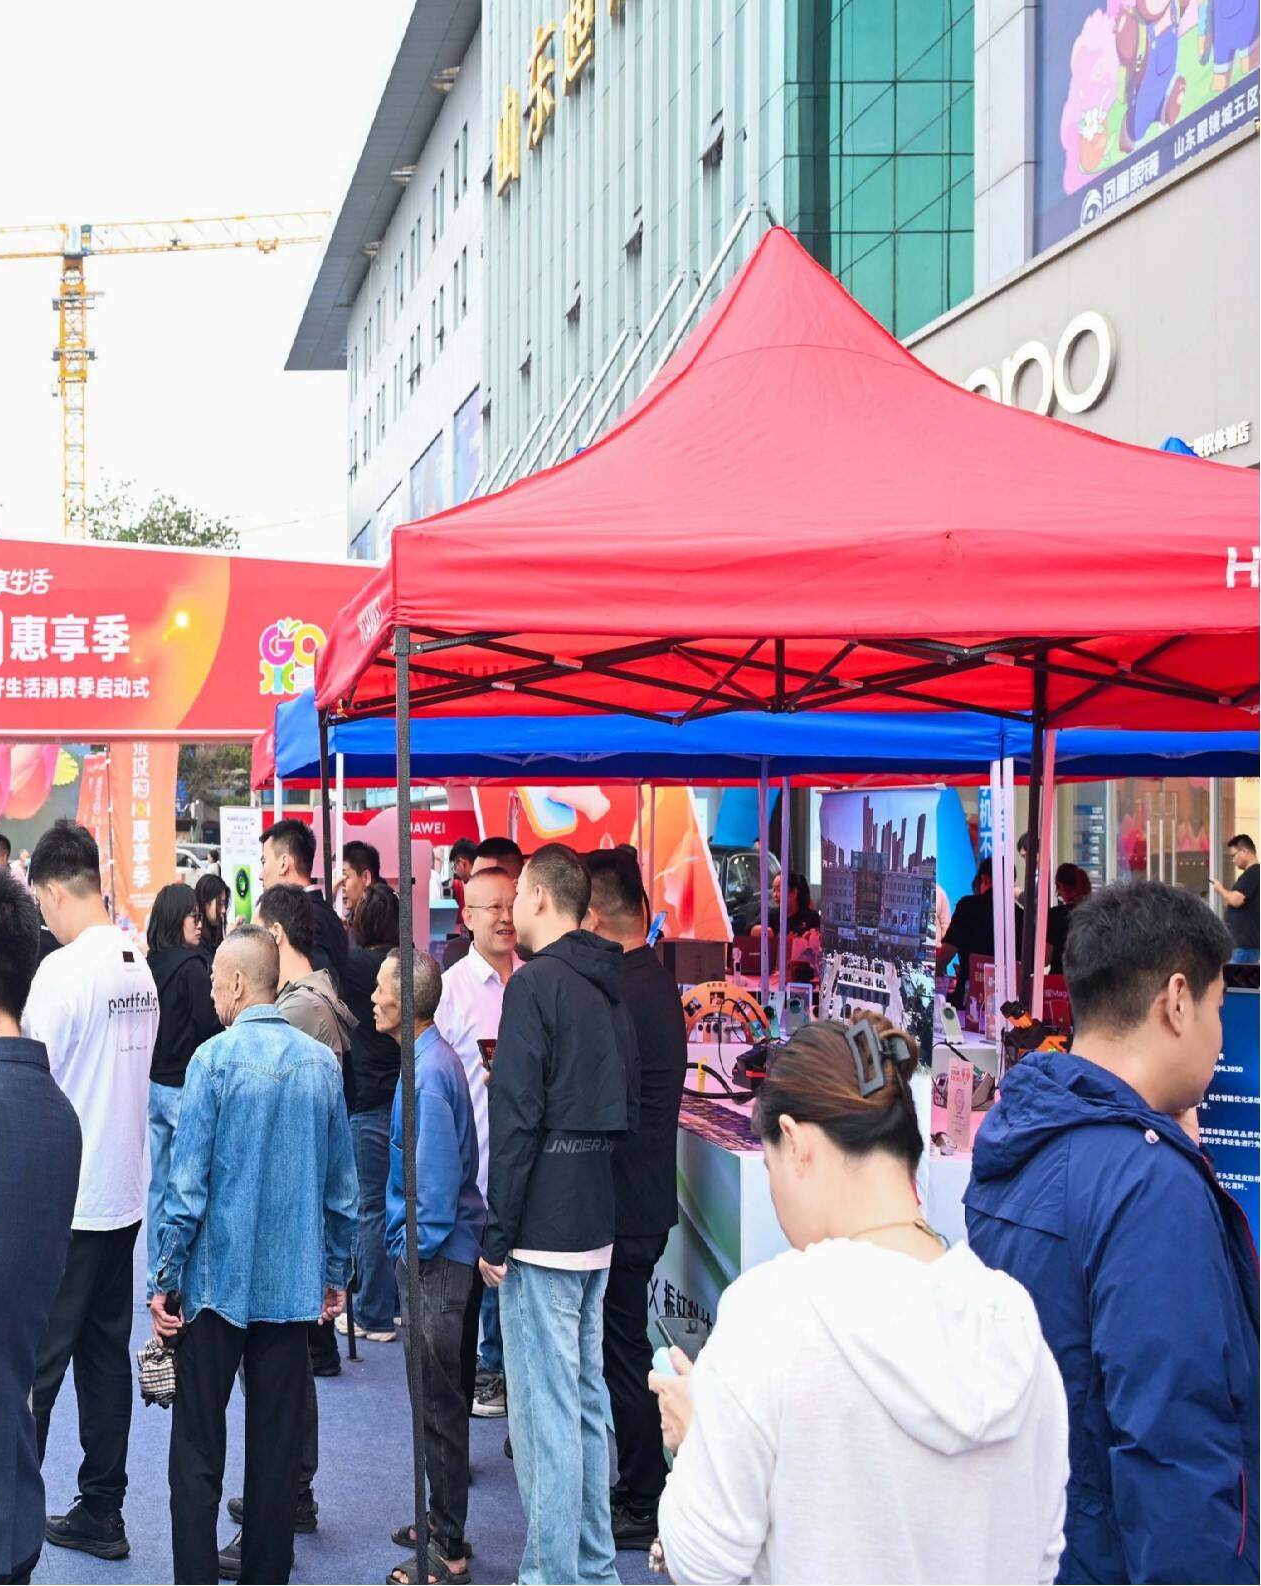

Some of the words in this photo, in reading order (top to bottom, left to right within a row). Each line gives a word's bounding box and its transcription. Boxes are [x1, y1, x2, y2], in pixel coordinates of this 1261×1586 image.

[497, 0, 619, 197] 山东通
[411, 822, 446, 835] AWEI
